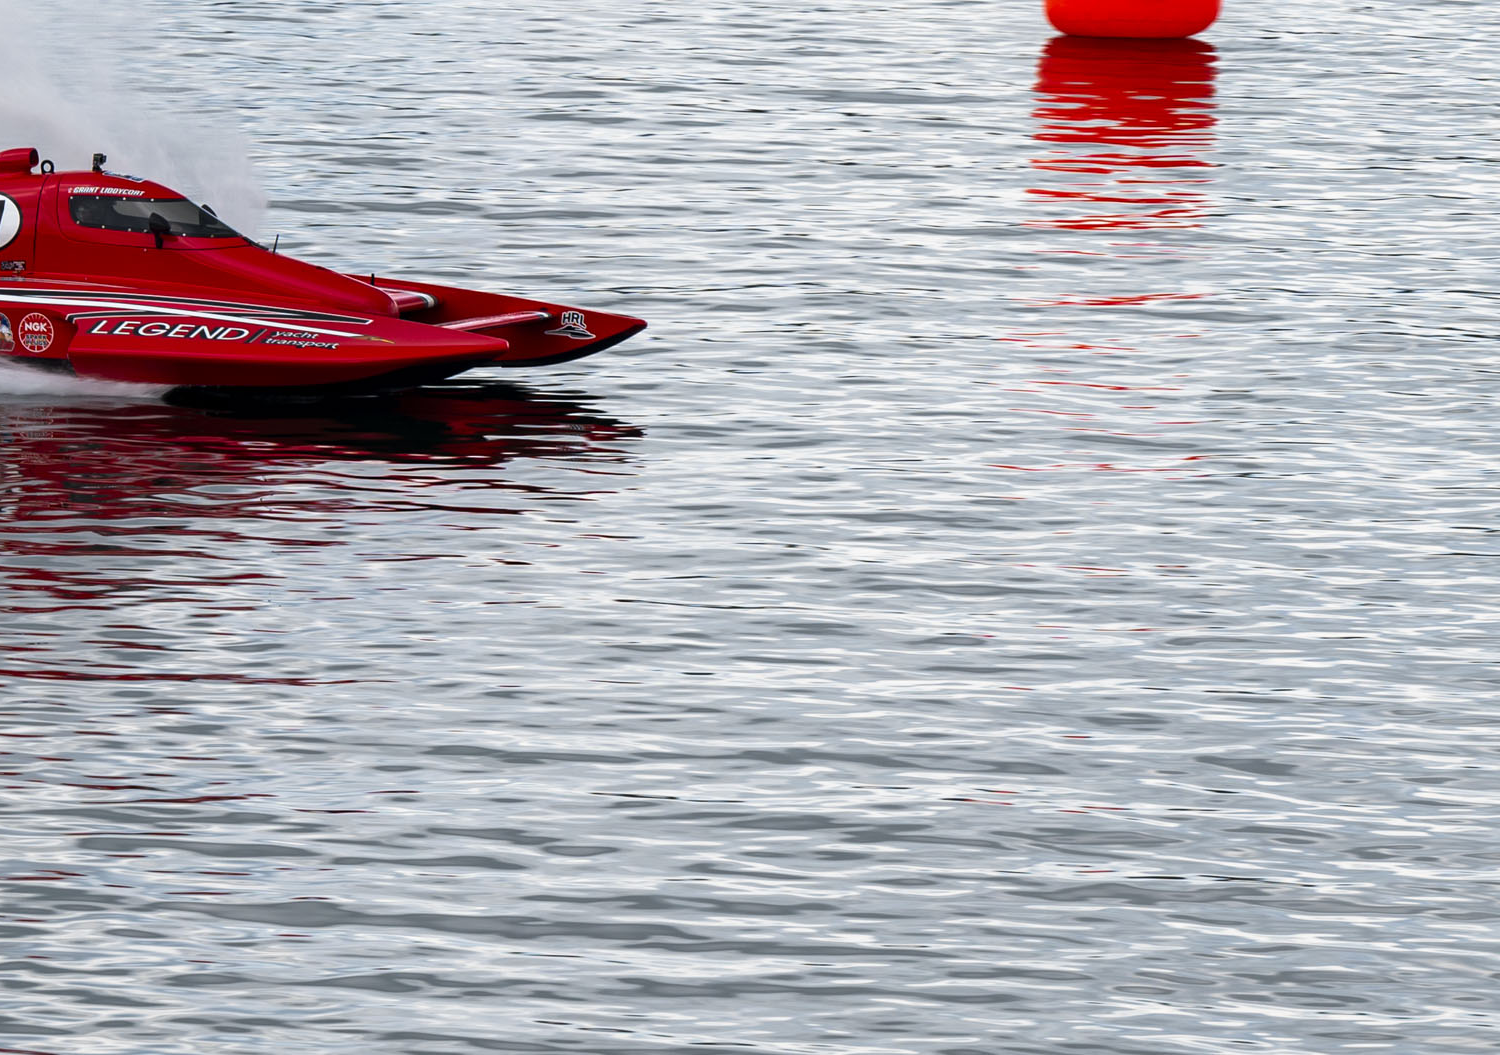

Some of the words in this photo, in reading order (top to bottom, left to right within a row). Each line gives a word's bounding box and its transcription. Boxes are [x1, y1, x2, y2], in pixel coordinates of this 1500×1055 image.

[72, 186, 100, 194] GRANT
[562, 311, 587, 329] HRL
[24, 322, 47, 332] NGK
[90, 319, 250, 341] LEGEND
[271, 330, 319, 340] yacht
[265, 337, 340, 350] transport
